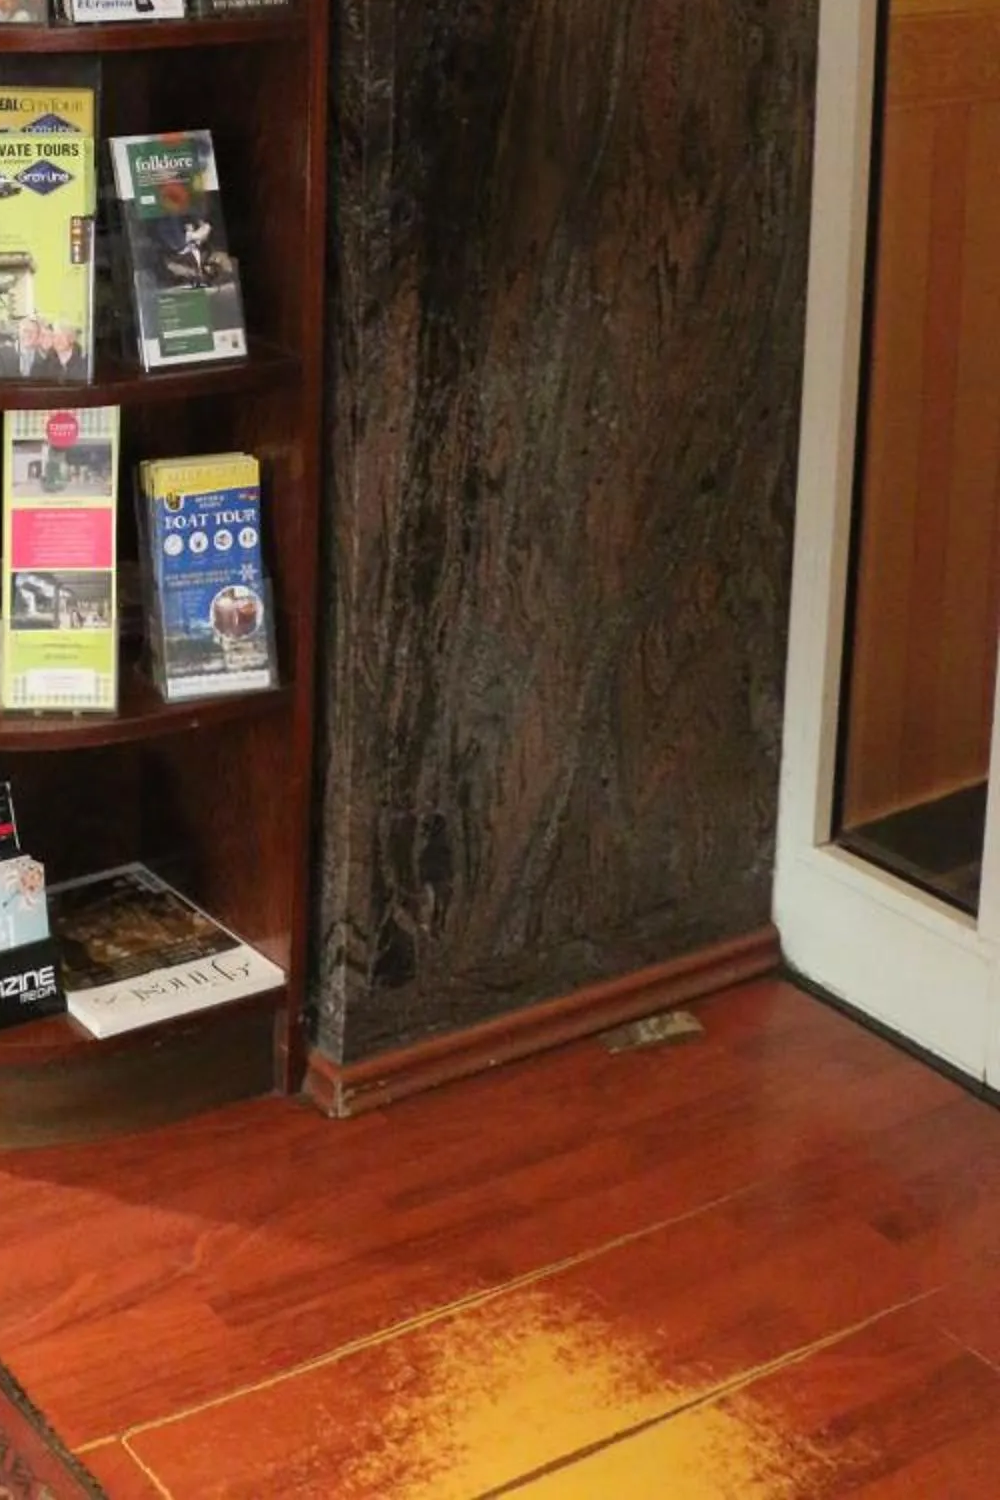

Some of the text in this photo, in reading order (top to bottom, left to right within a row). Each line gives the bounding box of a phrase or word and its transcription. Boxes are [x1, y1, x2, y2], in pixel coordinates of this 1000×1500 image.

[35, 142, 80, 157] TOURS
[135, 155, 194, 174] folklore
[165, 508, 258, 530] BOAT TOUR
[19, 984, 58, 1005] MEDIA
